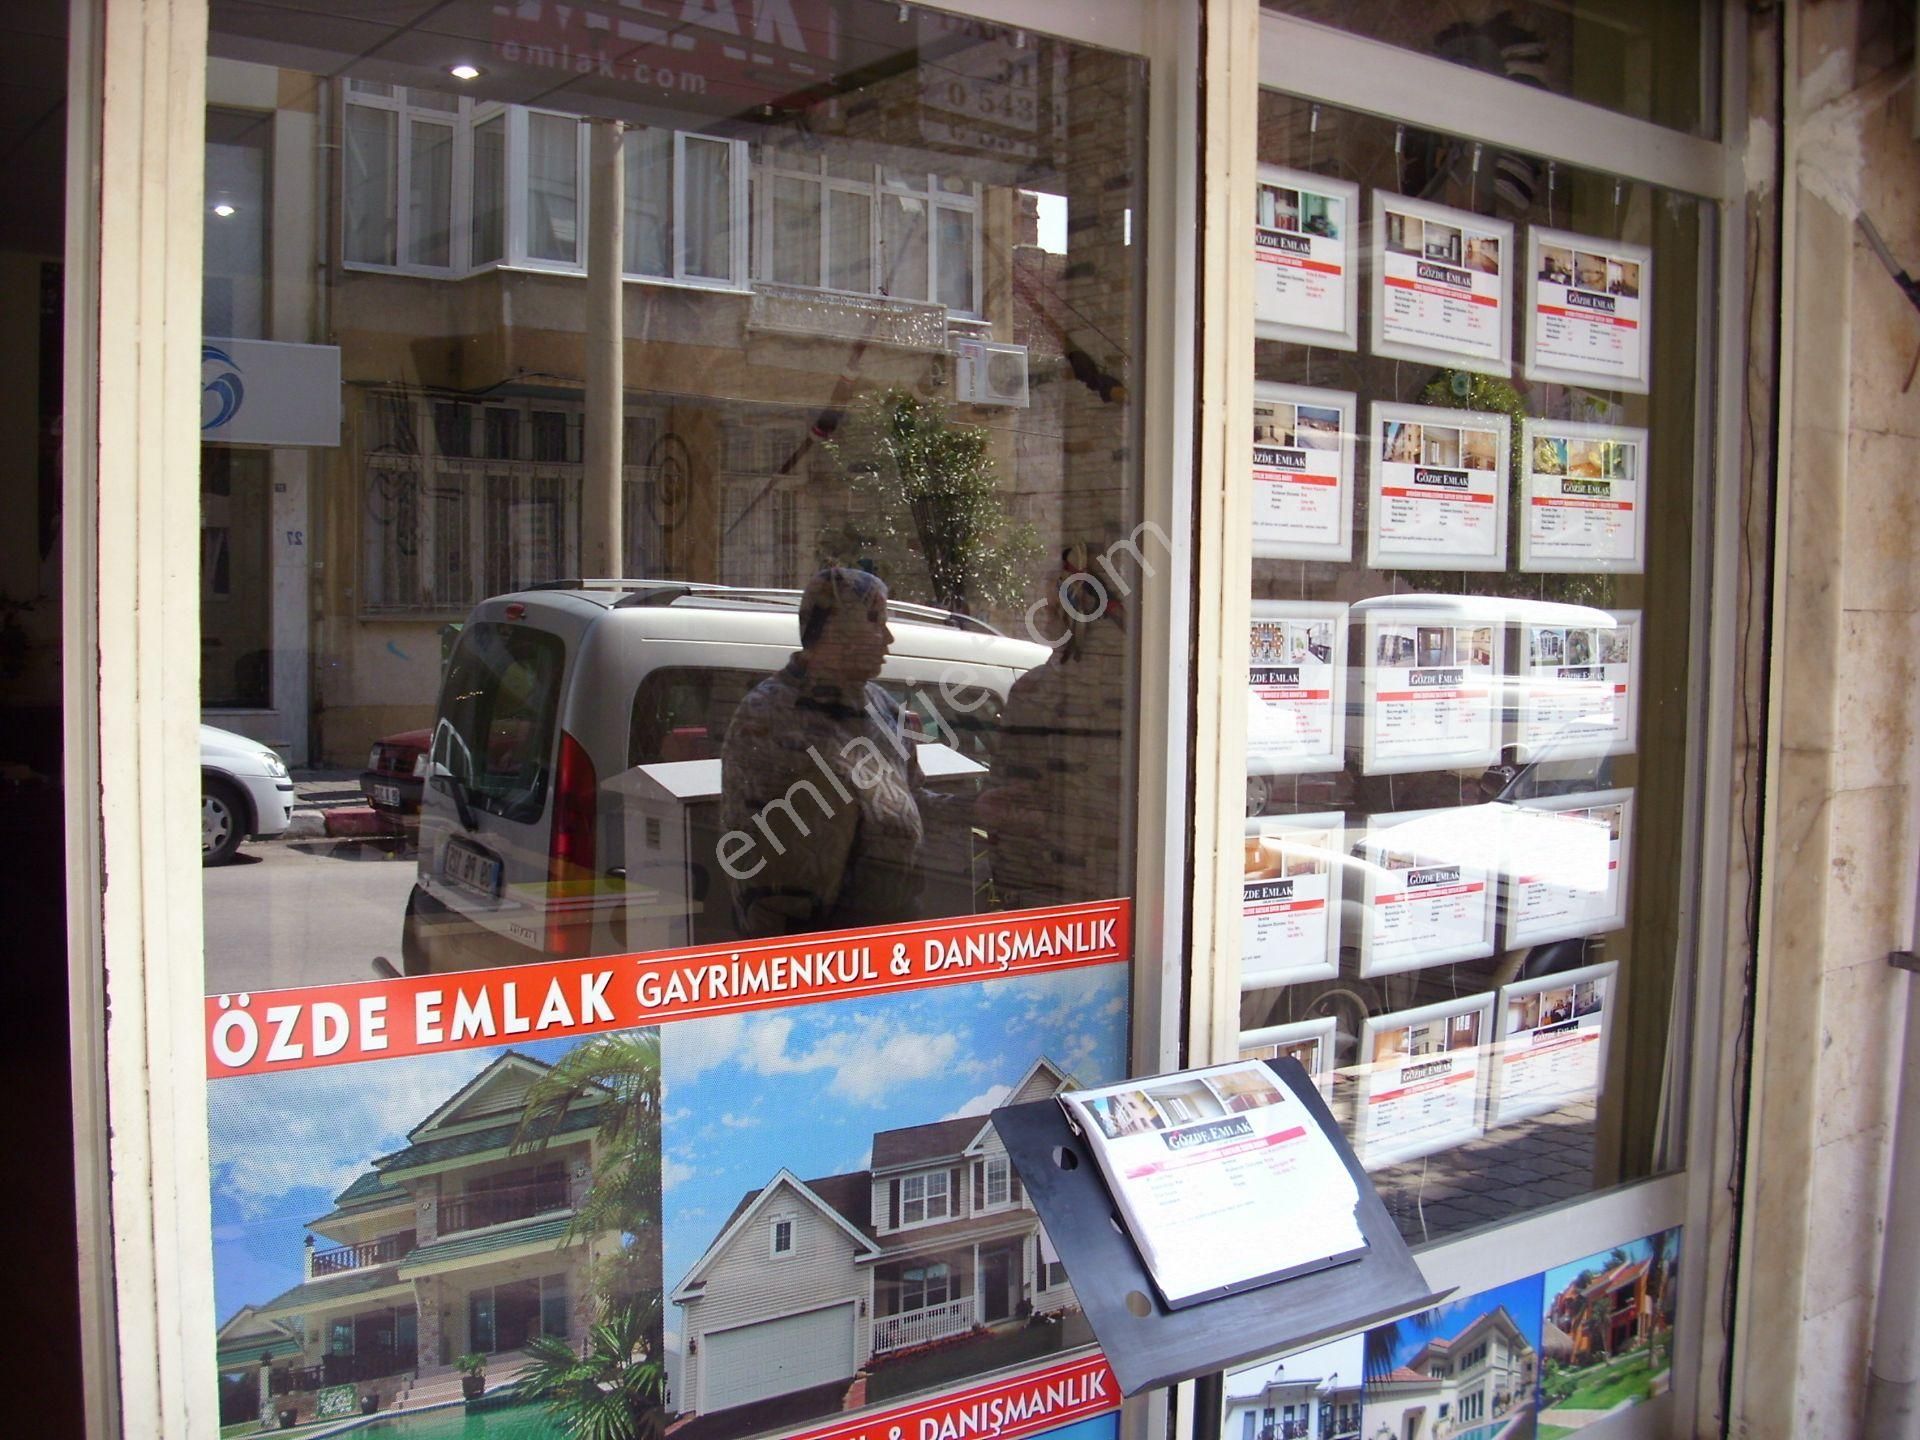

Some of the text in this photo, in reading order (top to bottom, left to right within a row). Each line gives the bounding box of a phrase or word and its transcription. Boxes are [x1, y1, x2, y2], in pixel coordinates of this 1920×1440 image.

[501, 39, 708, 95] emlak.com
[1280, 237, 1310, 254] EMLAK
[1446, 271, 1472, 287] EMLAK
[1275, 453, 1306, 467] EMLAK
[1443, 474, 1469, 488] EMLAK
[1269, 671, 1299, 684] EMLAK
[1435, 869, 1460, 883] EMLAK
[1262, 885, 1294, 899] EMLAK
[211, 917, 1118, 1069] ÖZDE EMLAK GAYRİMENKUL & DANIŞMANLIK
[1168, 1121, 1253, 1150] GÖZDE EMLAK
[919, 1368, 1108, 1440] DANIŞMANLIK
